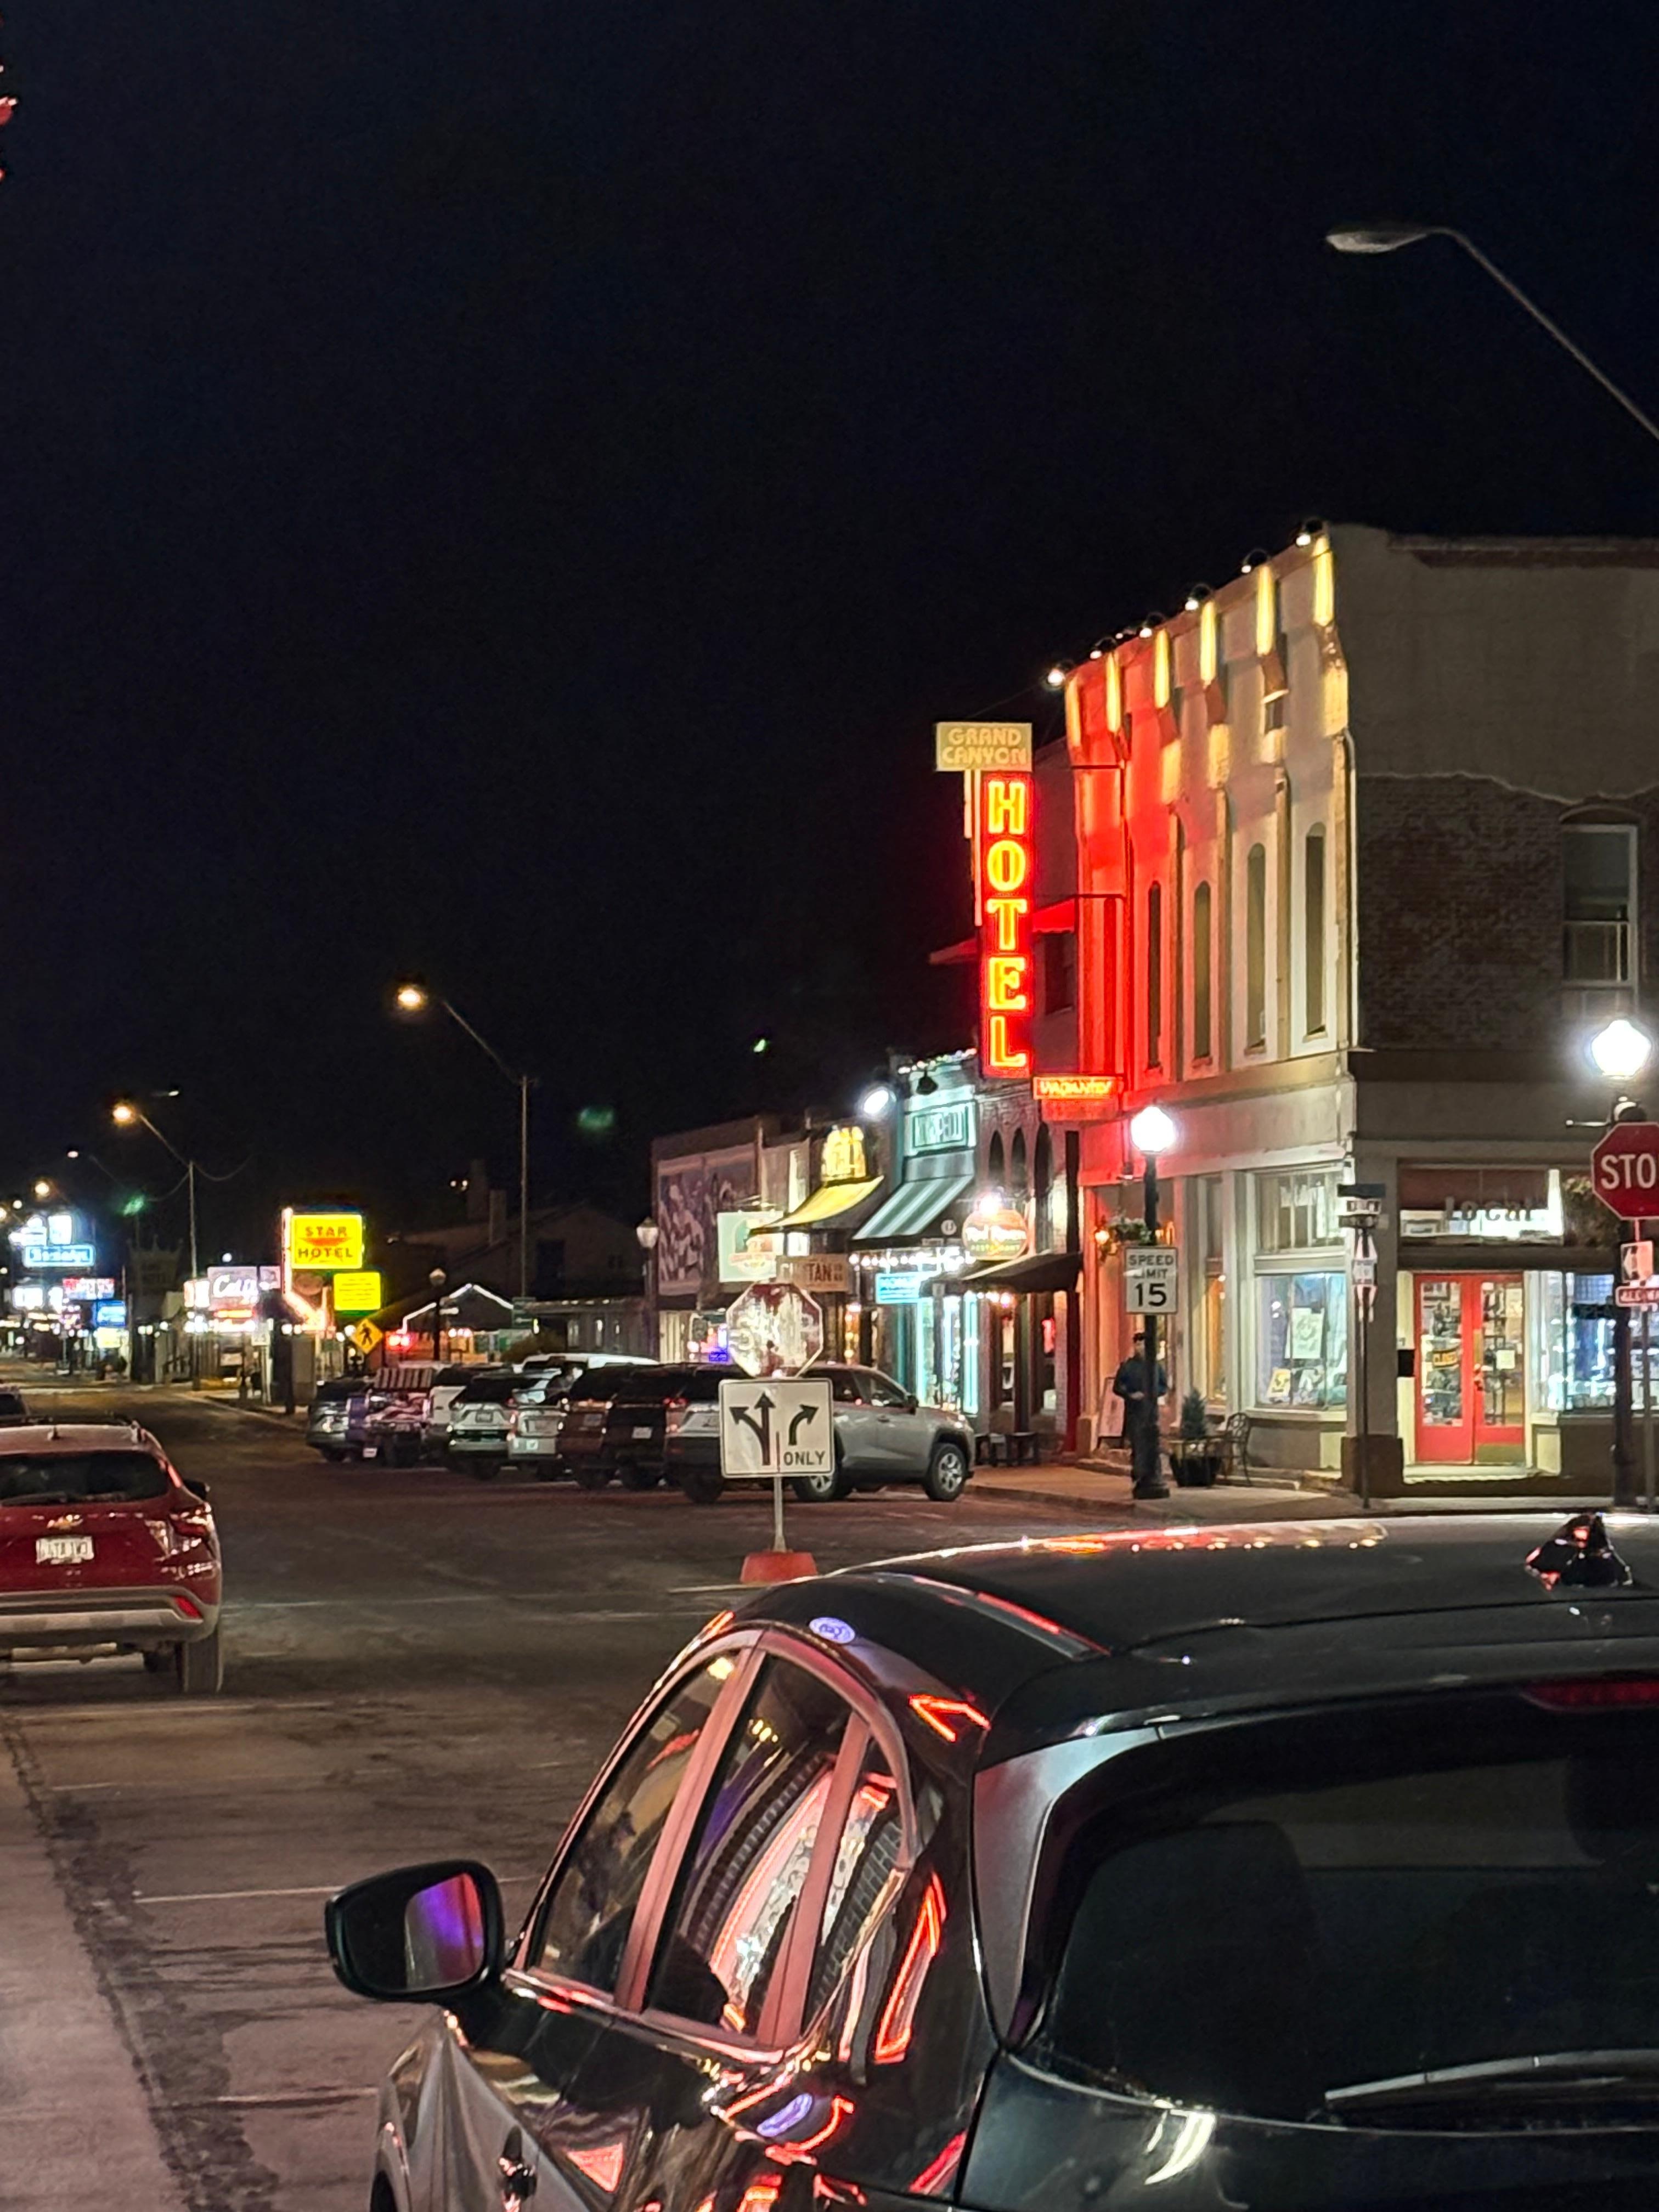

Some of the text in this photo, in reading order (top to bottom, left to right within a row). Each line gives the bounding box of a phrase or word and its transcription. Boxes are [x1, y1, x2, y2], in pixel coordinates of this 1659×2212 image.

[948, 727, 1022, 746] GRAND
[942, 747, 1026, 764] CANYON
[986, 781, 1028, 1067] HOTEL
[305, 1226, 348, 1237] STAR
[297, 1247, 354, 1259] HOTEL
[1128, 1254, 1174, 1266] SPEED
[1135, 1282, 1167, 1307] 15
[783, 1451, 826, 1466] ONLY
